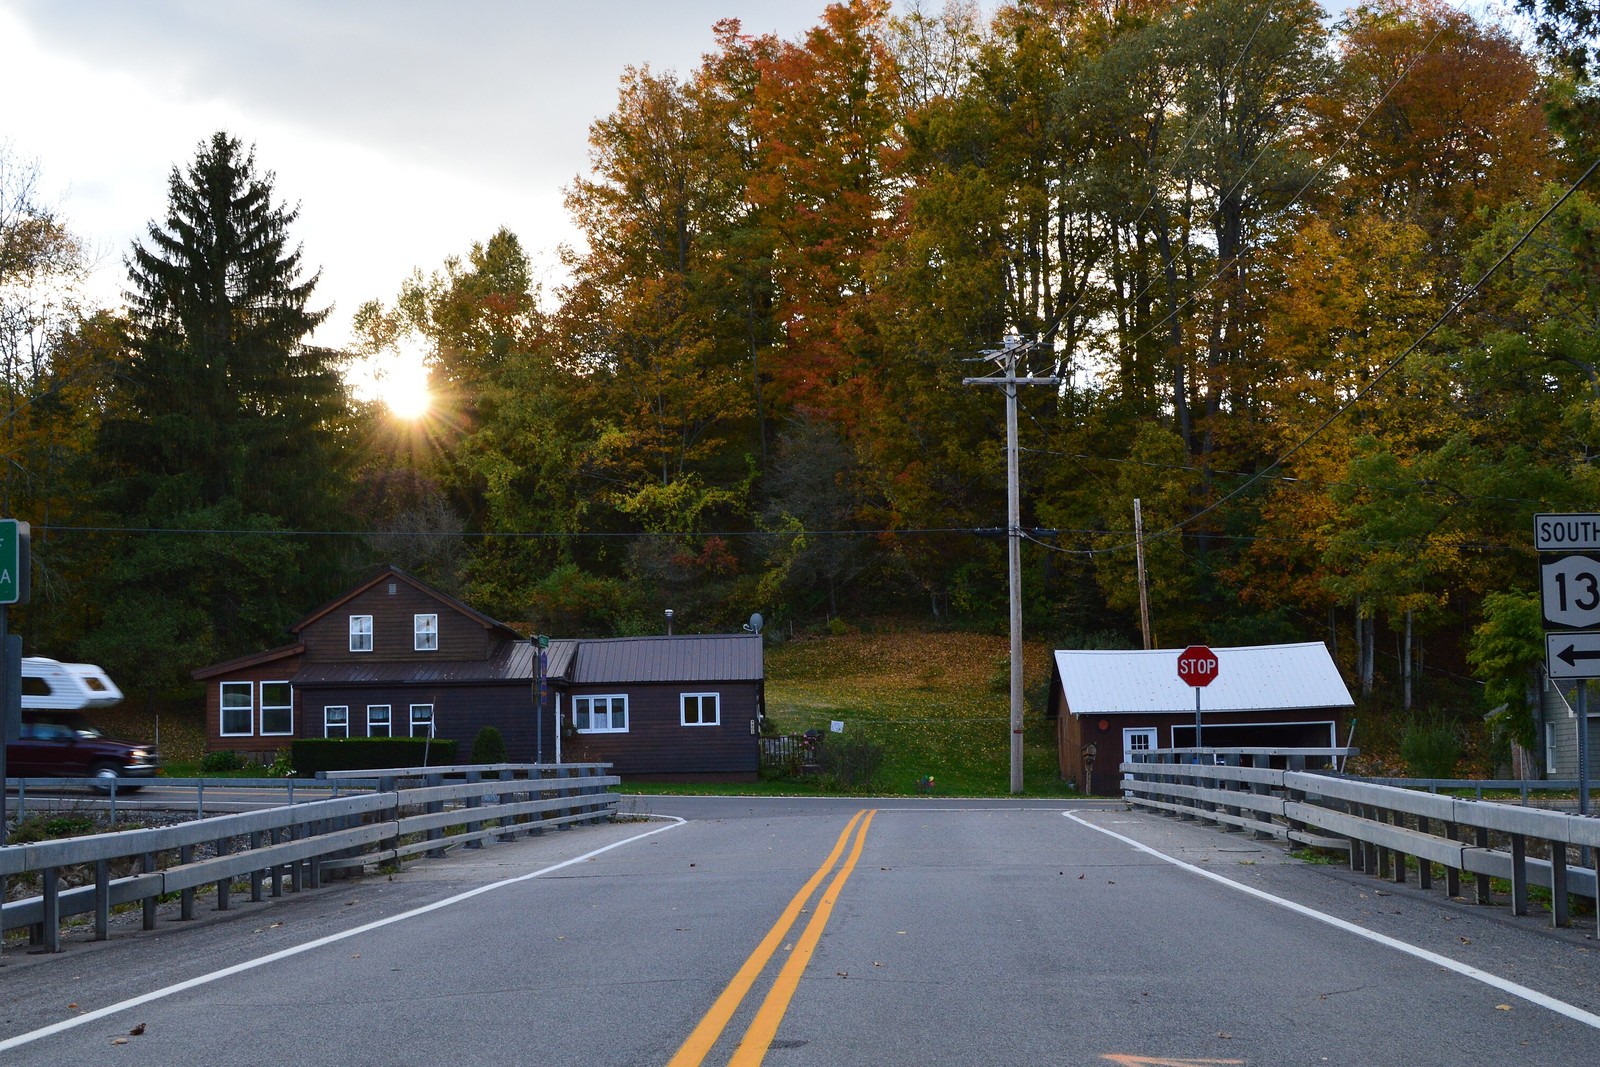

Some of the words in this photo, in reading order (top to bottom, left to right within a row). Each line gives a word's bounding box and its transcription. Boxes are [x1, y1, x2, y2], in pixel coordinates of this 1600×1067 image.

[1541, 522, 1600, 542] SOUTH
[1555, 572, 1600, 611] 13
[1180, 658, 1216, 674] STOP
